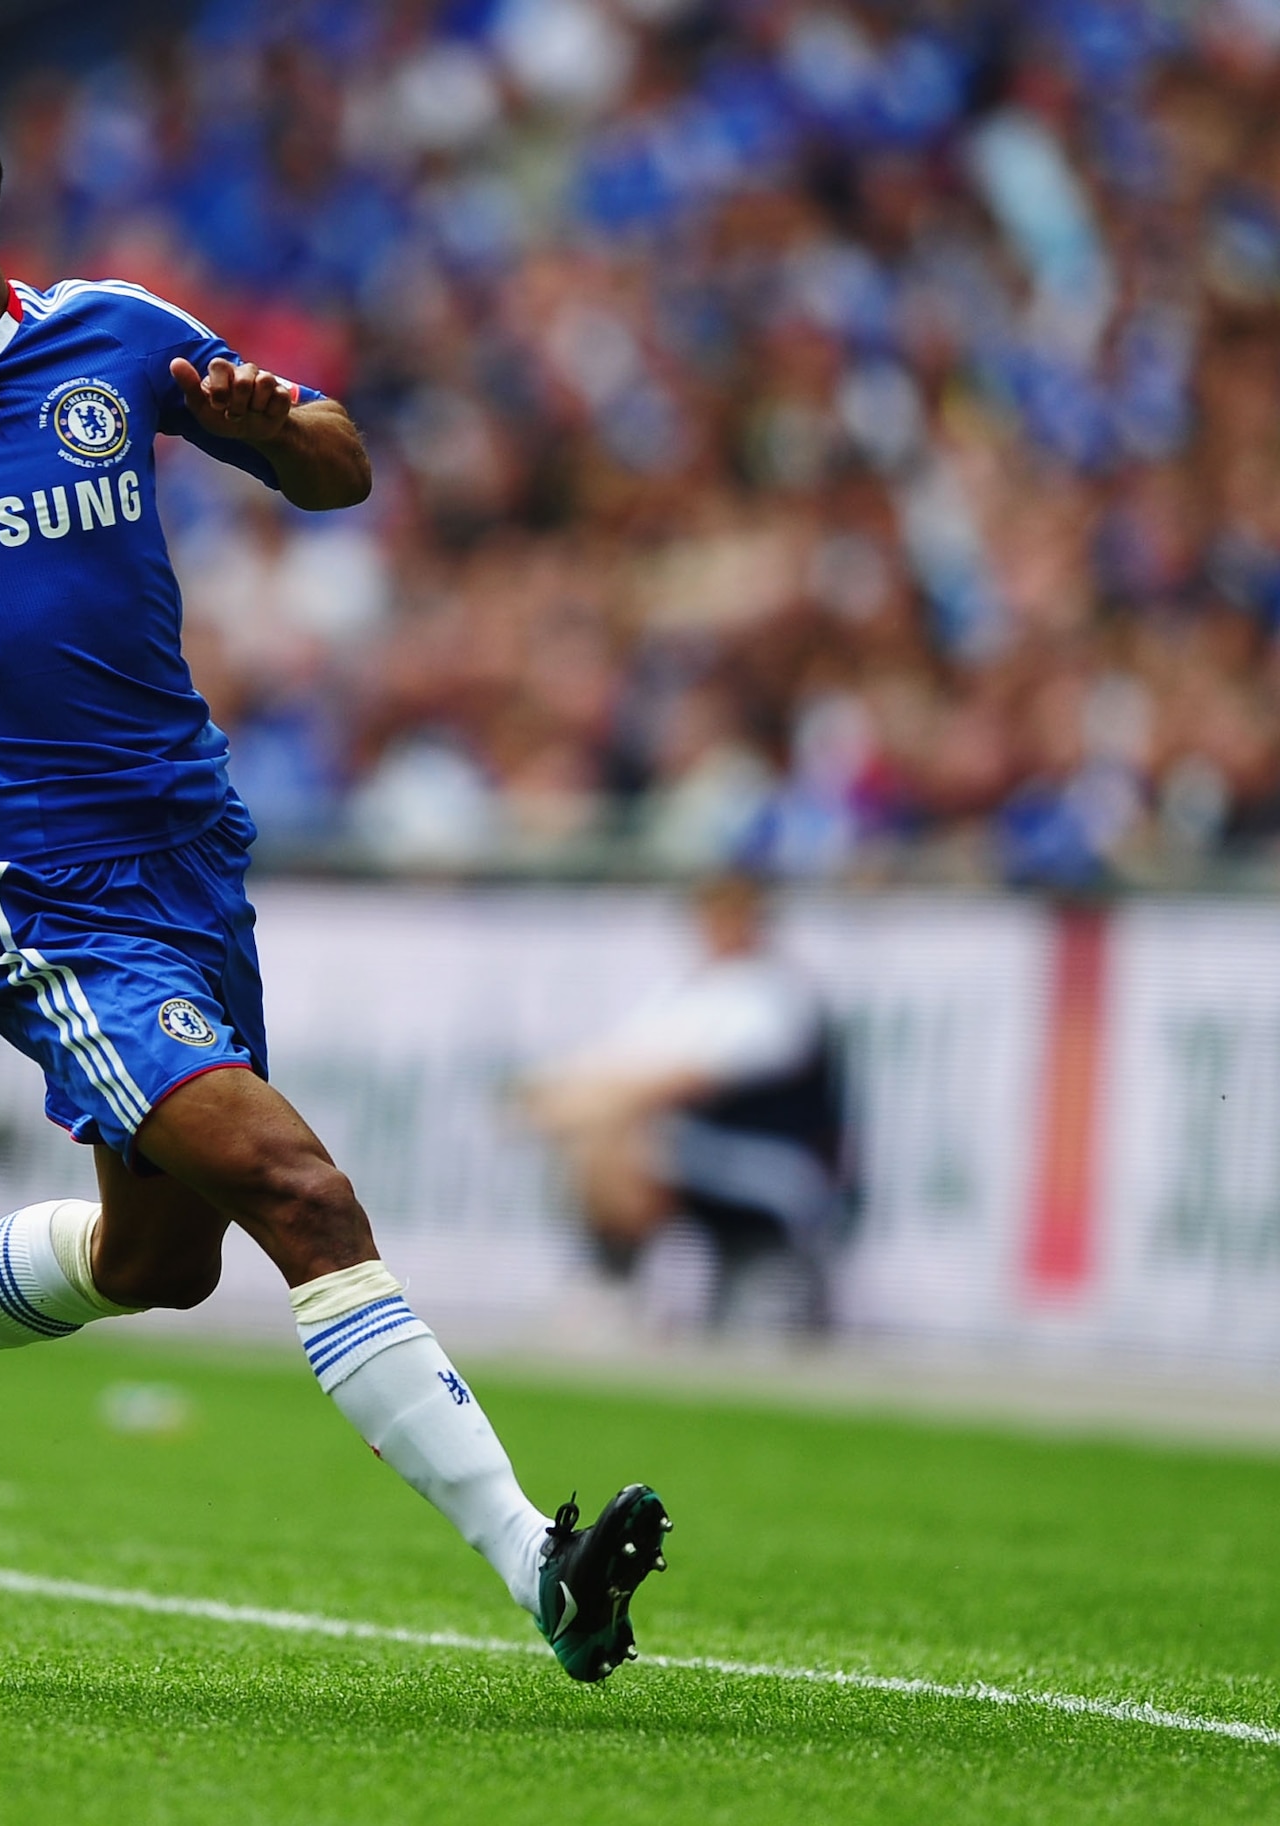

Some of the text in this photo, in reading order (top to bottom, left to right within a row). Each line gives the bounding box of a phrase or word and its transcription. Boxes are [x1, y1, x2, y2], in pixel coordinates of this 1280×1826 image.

[41, 402, 51, 412] FA
[63, 392, 105, 411] CHELSEA
[57, 448, 96, 468] WEMBLEY
